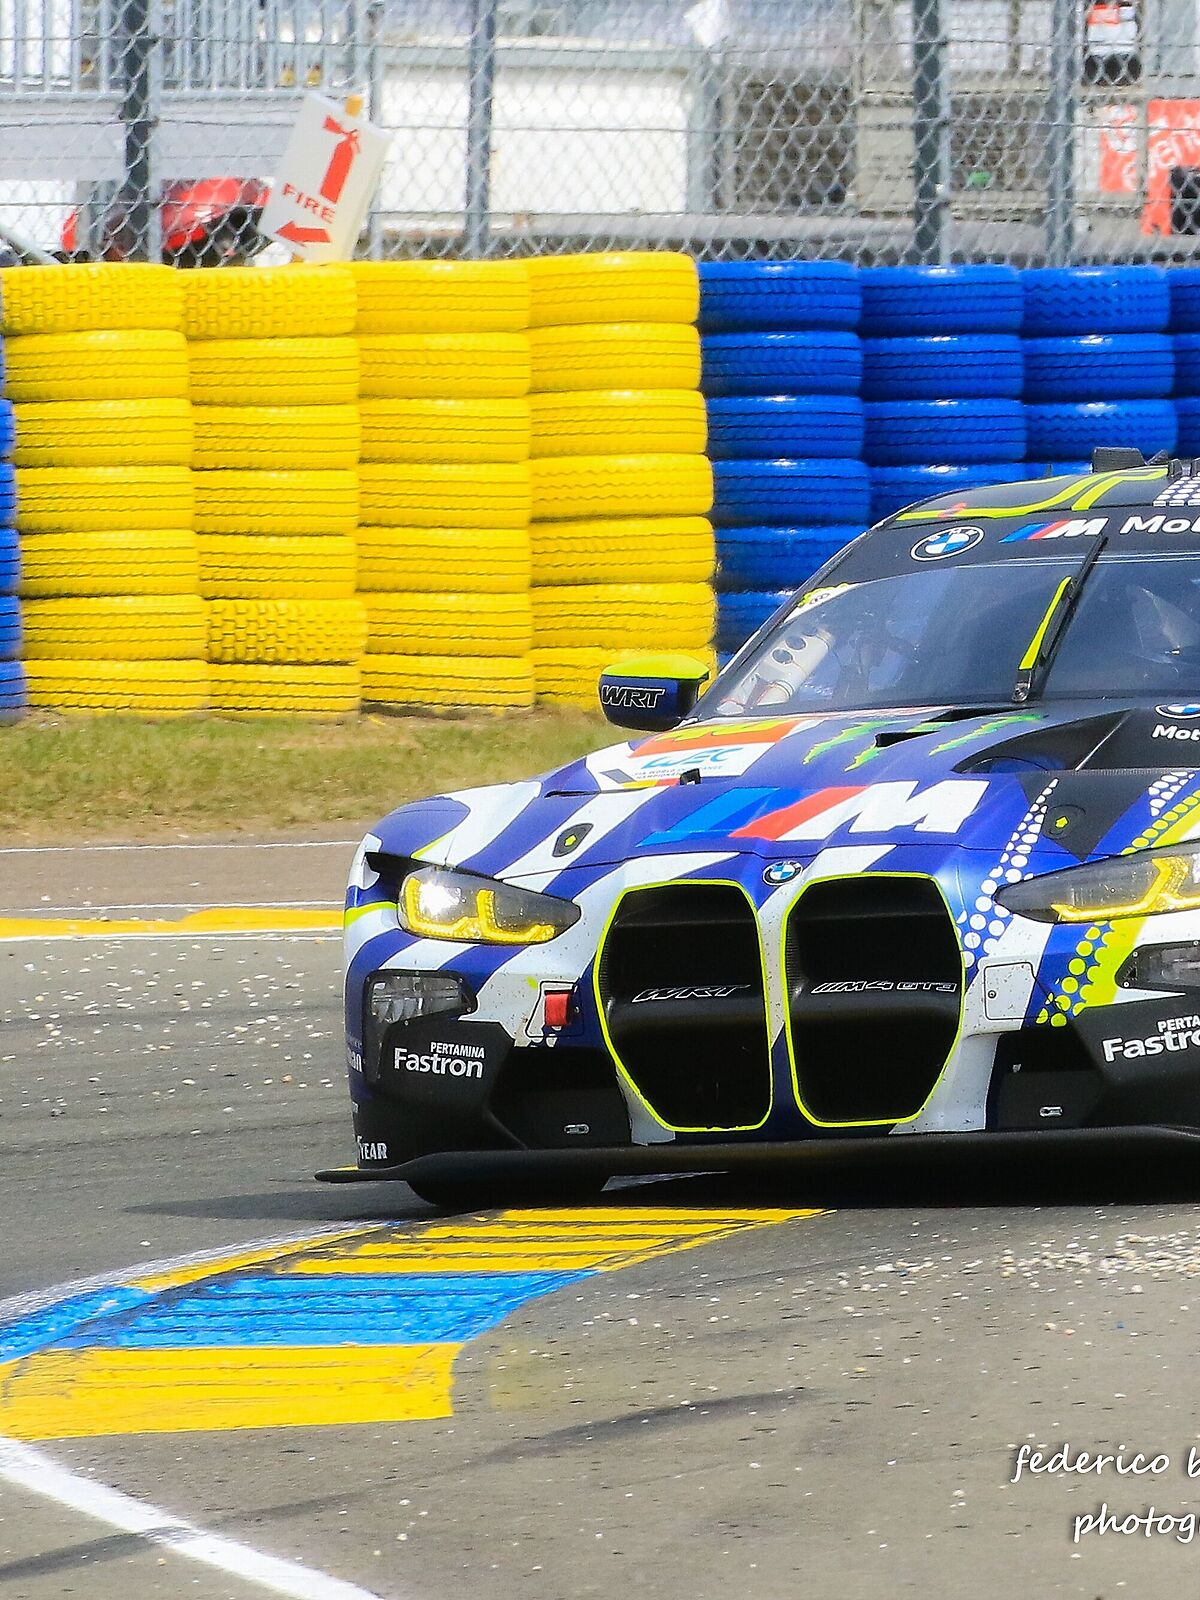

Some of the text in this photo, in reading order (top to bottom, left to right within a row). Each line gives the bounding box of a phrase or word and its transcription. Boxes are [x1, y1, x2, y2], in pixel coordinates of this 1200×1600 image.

[282, 183, 335, 224] FIRE
[601, 685, 666, 708] WRT
[632, 984, 751, 1003] WRT
[430, 1041, 485, 1059] PERTAMINA
[394, 1047, 483, 1078] Fastron
